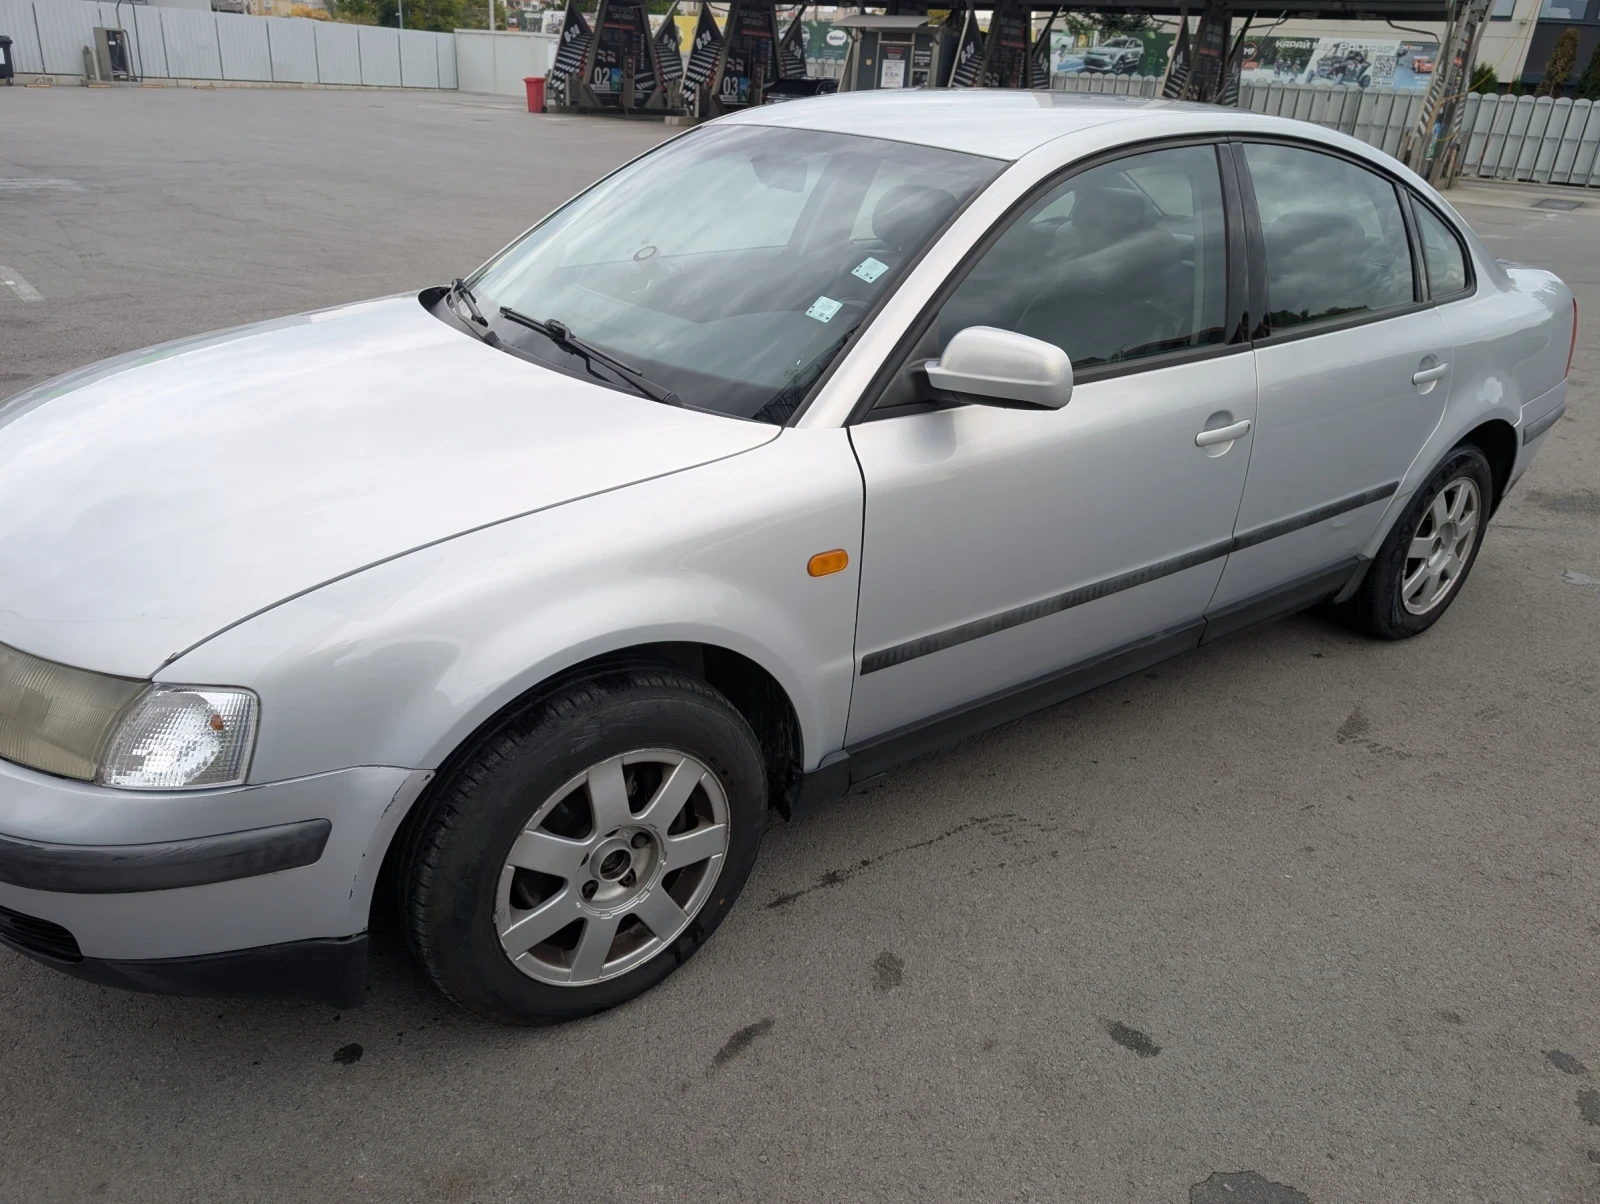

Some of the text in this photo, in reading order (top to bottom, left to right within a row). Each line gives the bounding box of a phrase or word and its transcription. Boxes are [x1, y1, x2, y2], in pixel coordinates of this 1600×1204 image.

[564, 24, 580, 42] 0-24
[696, 30, 711, 49] 0-24
[663, 34, 676, 52] 0-24
[1275, 40, 1311, 49] КАРАЙ
[1339, 43, 1392, 53] POLARIS
[594, 66, 610, 85] 02
[723, 76, 738, 95] 03
